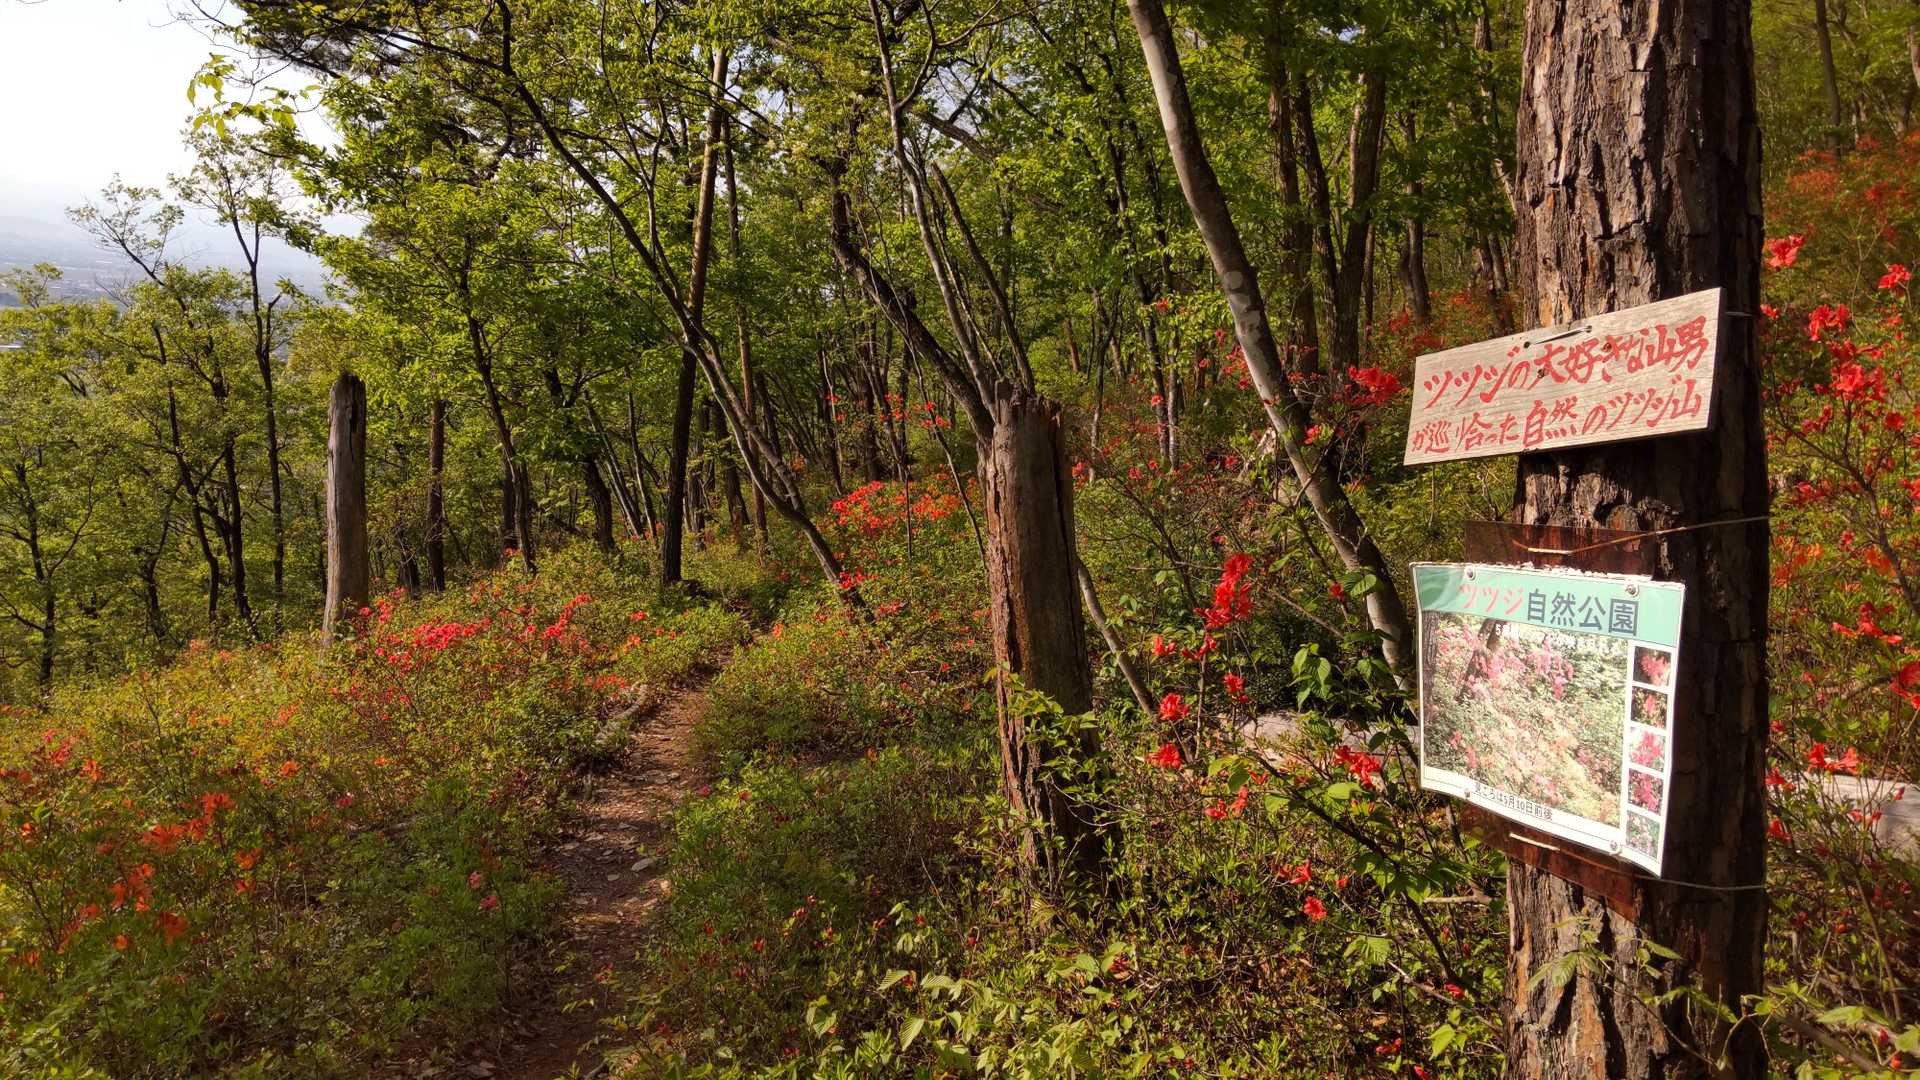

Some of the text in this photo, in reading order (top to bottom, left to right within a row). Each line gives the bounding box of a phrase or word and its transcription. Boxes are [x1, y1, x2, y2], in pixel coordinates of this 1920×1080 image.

[1423, 315, 1711, 409] ツツジの大好きな山男
[1457, 582, 1639, 637] ツツジ自然公園
